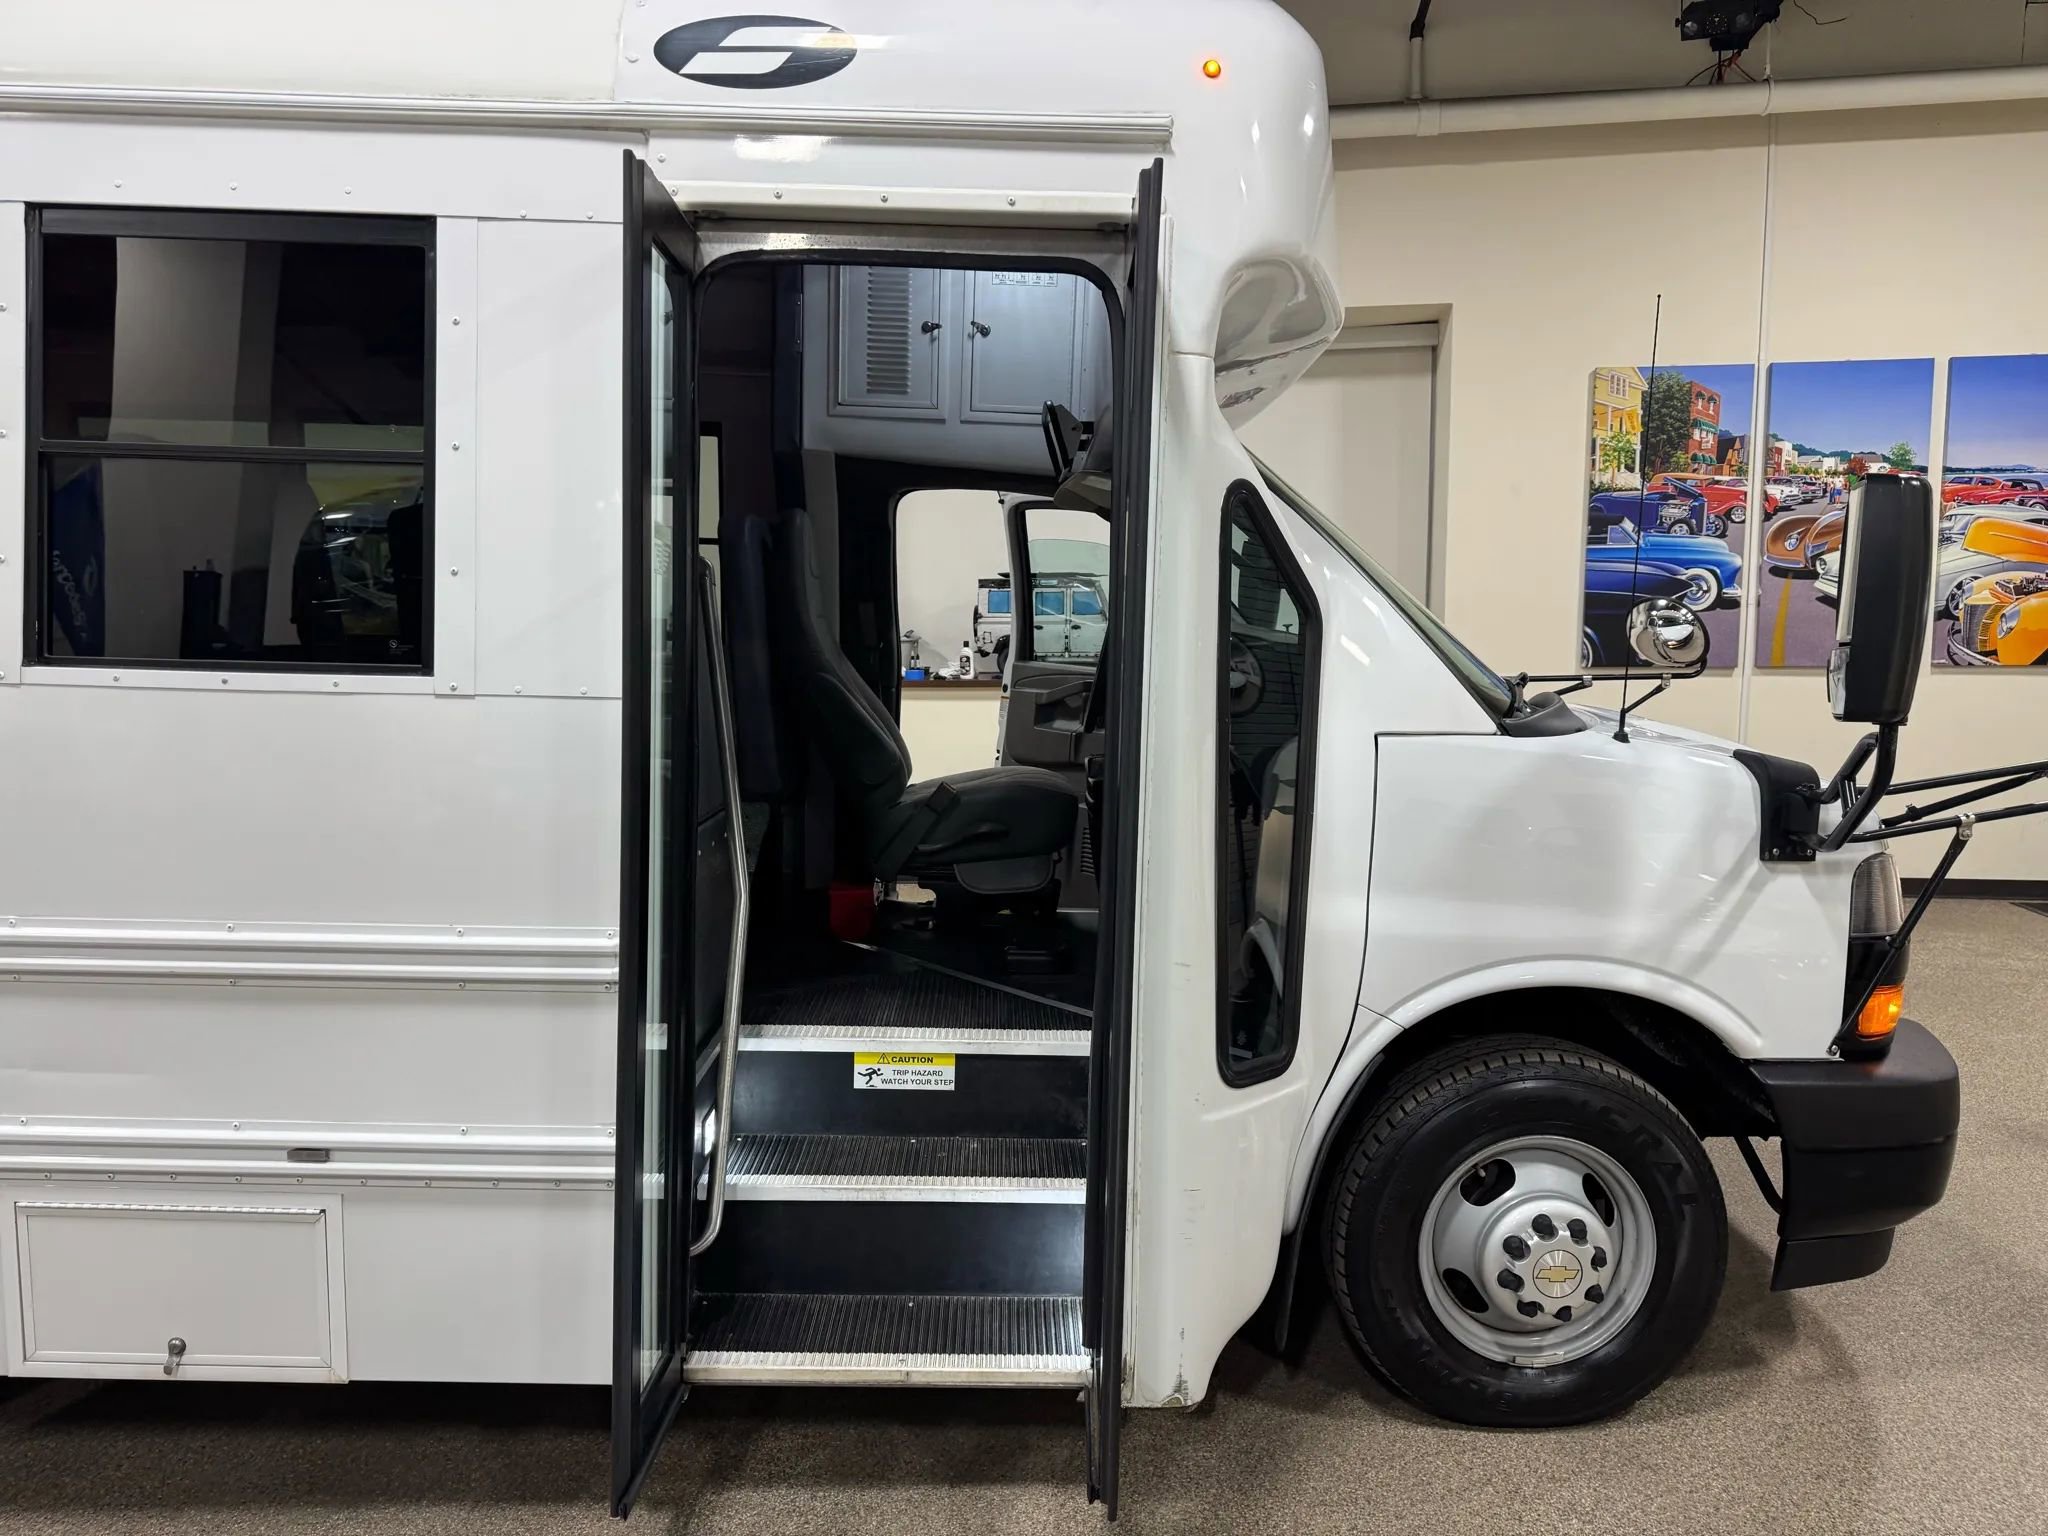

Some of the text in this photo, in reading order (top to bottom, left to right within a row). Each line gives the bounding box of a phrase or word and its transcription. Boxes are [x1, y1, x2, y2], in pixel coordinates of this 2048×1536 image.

[891, 1056, 934, 1064] CAUTION
[892, 1069, 910, 1077] TRIP
[910, 1078, 932, 1086] YOUR
